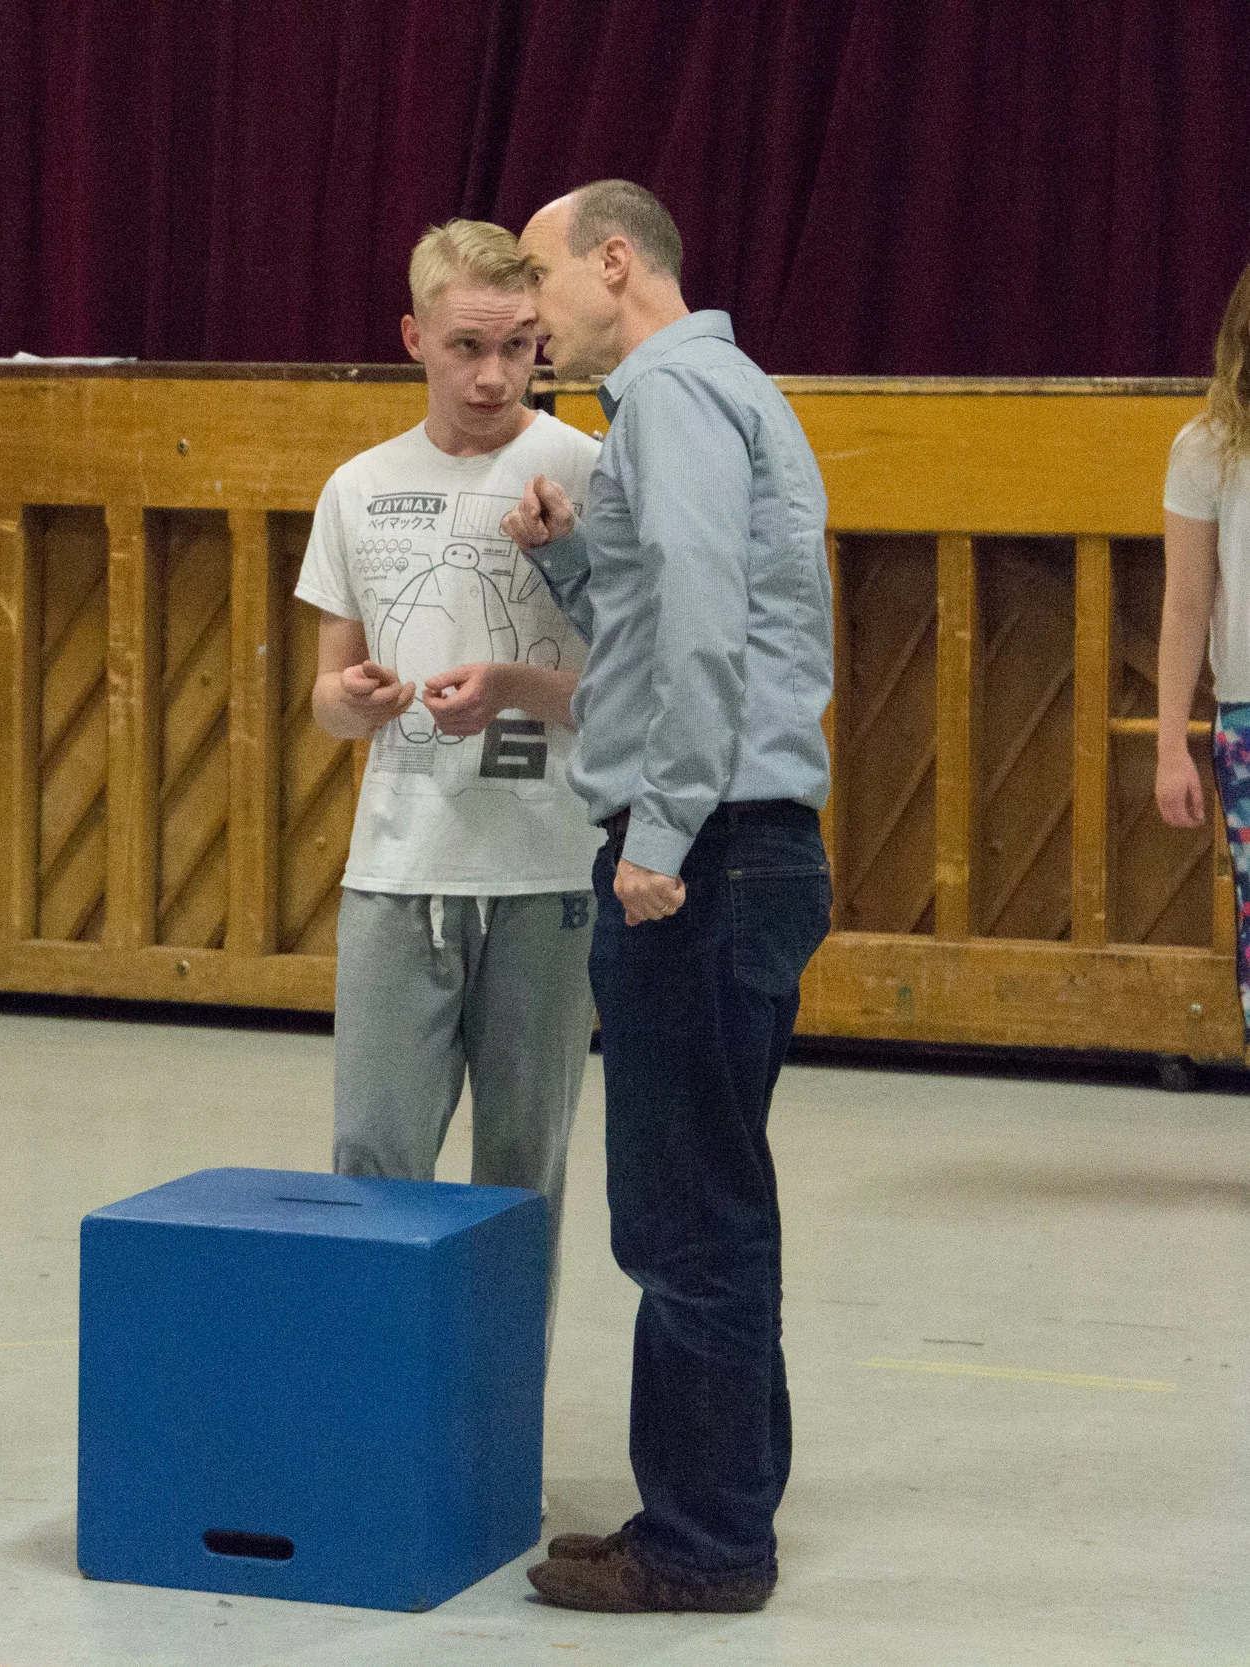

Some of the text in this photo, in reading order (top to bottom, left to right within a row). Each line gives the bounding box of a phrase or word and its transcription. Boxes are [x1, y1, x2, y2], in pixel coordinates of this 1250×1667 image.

[373, 498, 437, 513] BAYMAX
[368, 516, 436, 531] ベイマックス
[479, 719, 548, 779] 6
